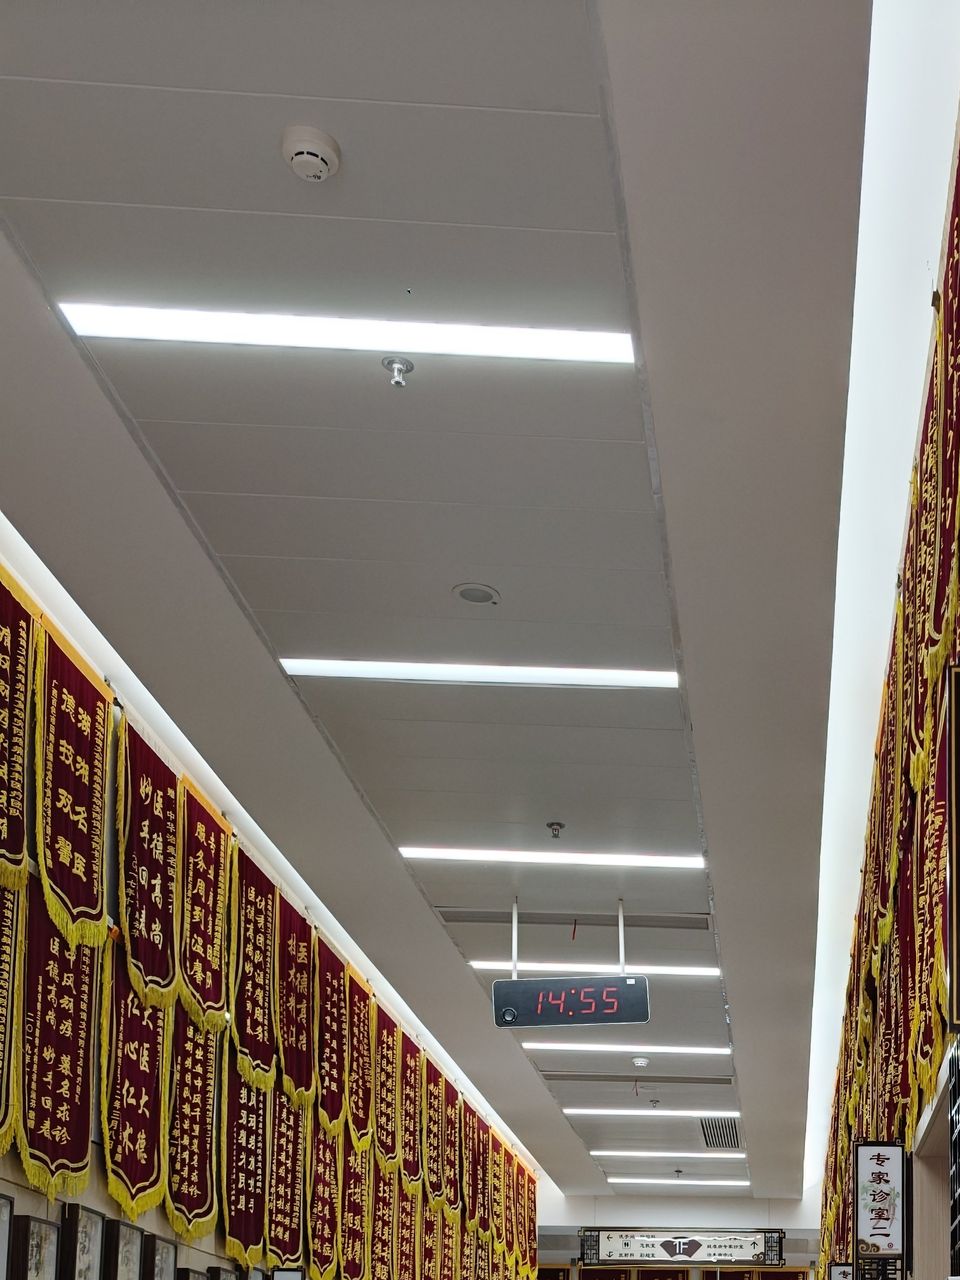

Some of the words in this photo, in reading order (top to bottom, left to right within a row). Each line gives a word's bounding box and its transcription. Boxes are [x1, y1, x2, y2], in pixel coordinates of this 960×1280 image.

[137, 775, 152, 939] 妙手回春
[150, 790, 164, 949] 医德高尚
[537, 987, 619, 1015] 14:55
[119, 992, 141, 1154] 仁心仁术
[673, 1240, 689, 1254] 1F
[869, 1152, 891, 1238] 专家诊室二
